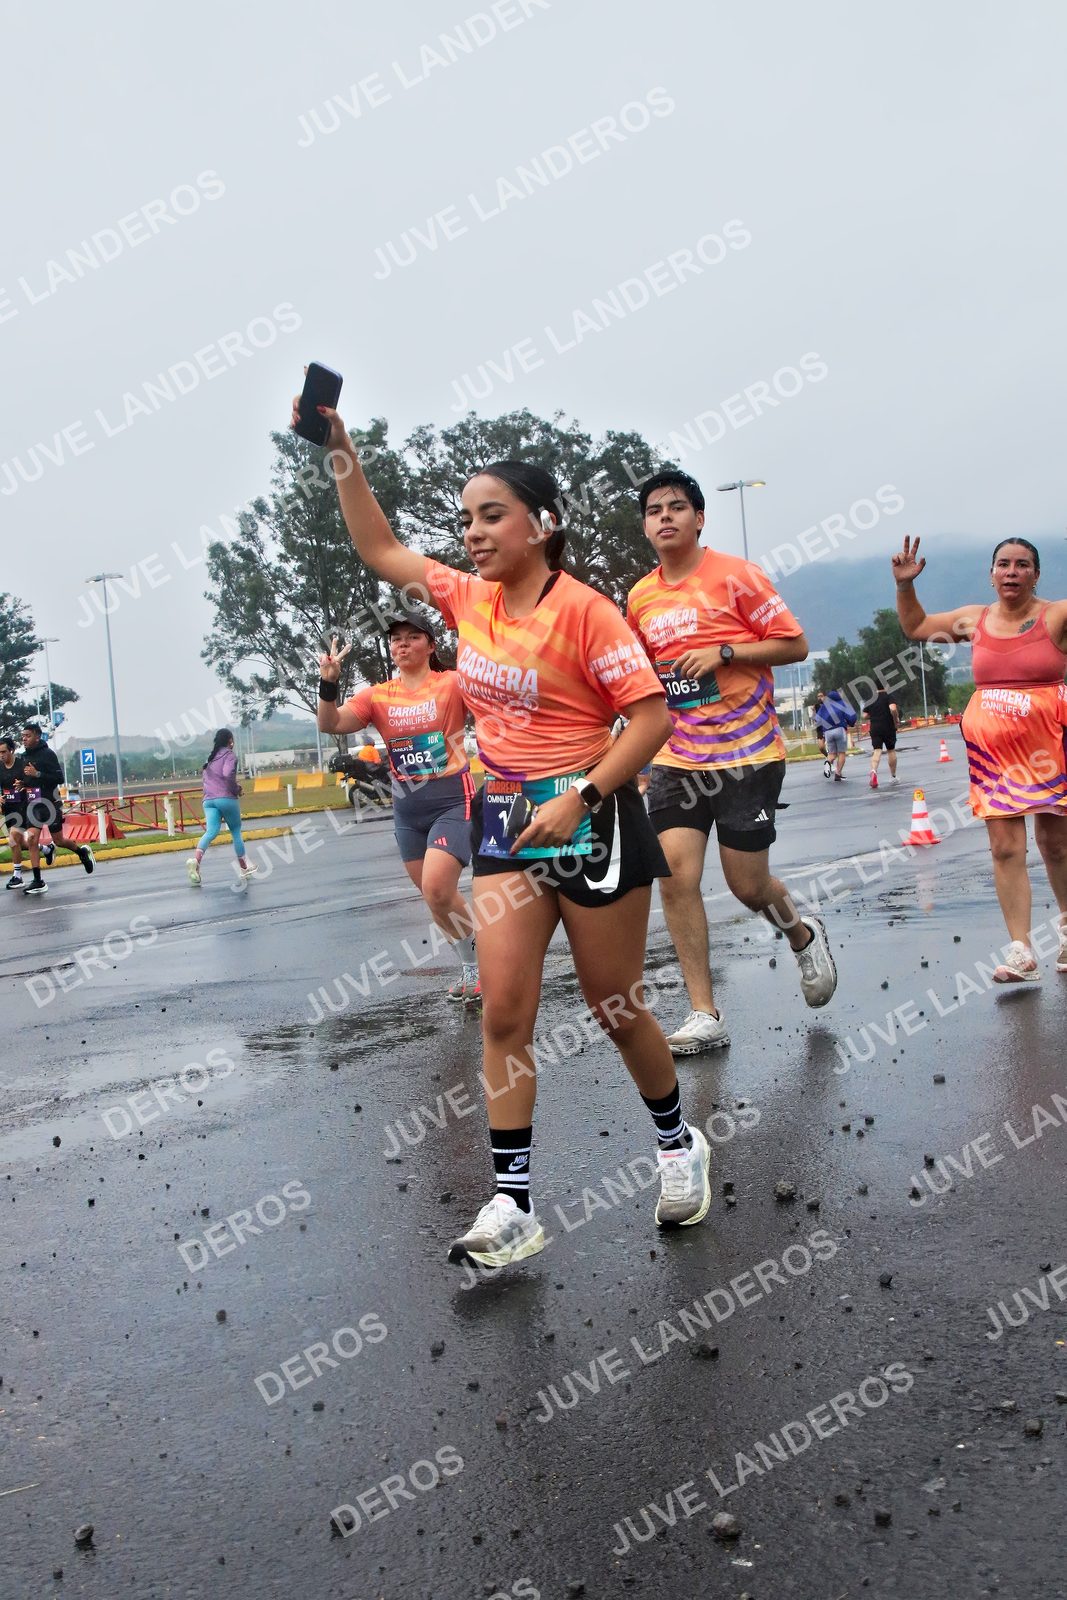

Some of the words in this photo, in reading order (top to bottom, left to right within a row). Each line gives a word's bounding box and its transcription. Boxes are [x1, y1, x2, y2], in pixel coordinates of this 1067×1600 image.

[649, 608, 698, 631] CARRERA
[459, 645, 538, 693] CARRERA
[666, 679, 700, 696] 1063
[388, 698, 437, 717] CARRERA
[389, 715, 426, 727] OMNILIFE
[428, 735, 439, 744] 10K
[399, 750, 432, 765] 1062
[487, 781, 522, 793] CARRERA
[487, 794, 513, 804] OMNILIFE
